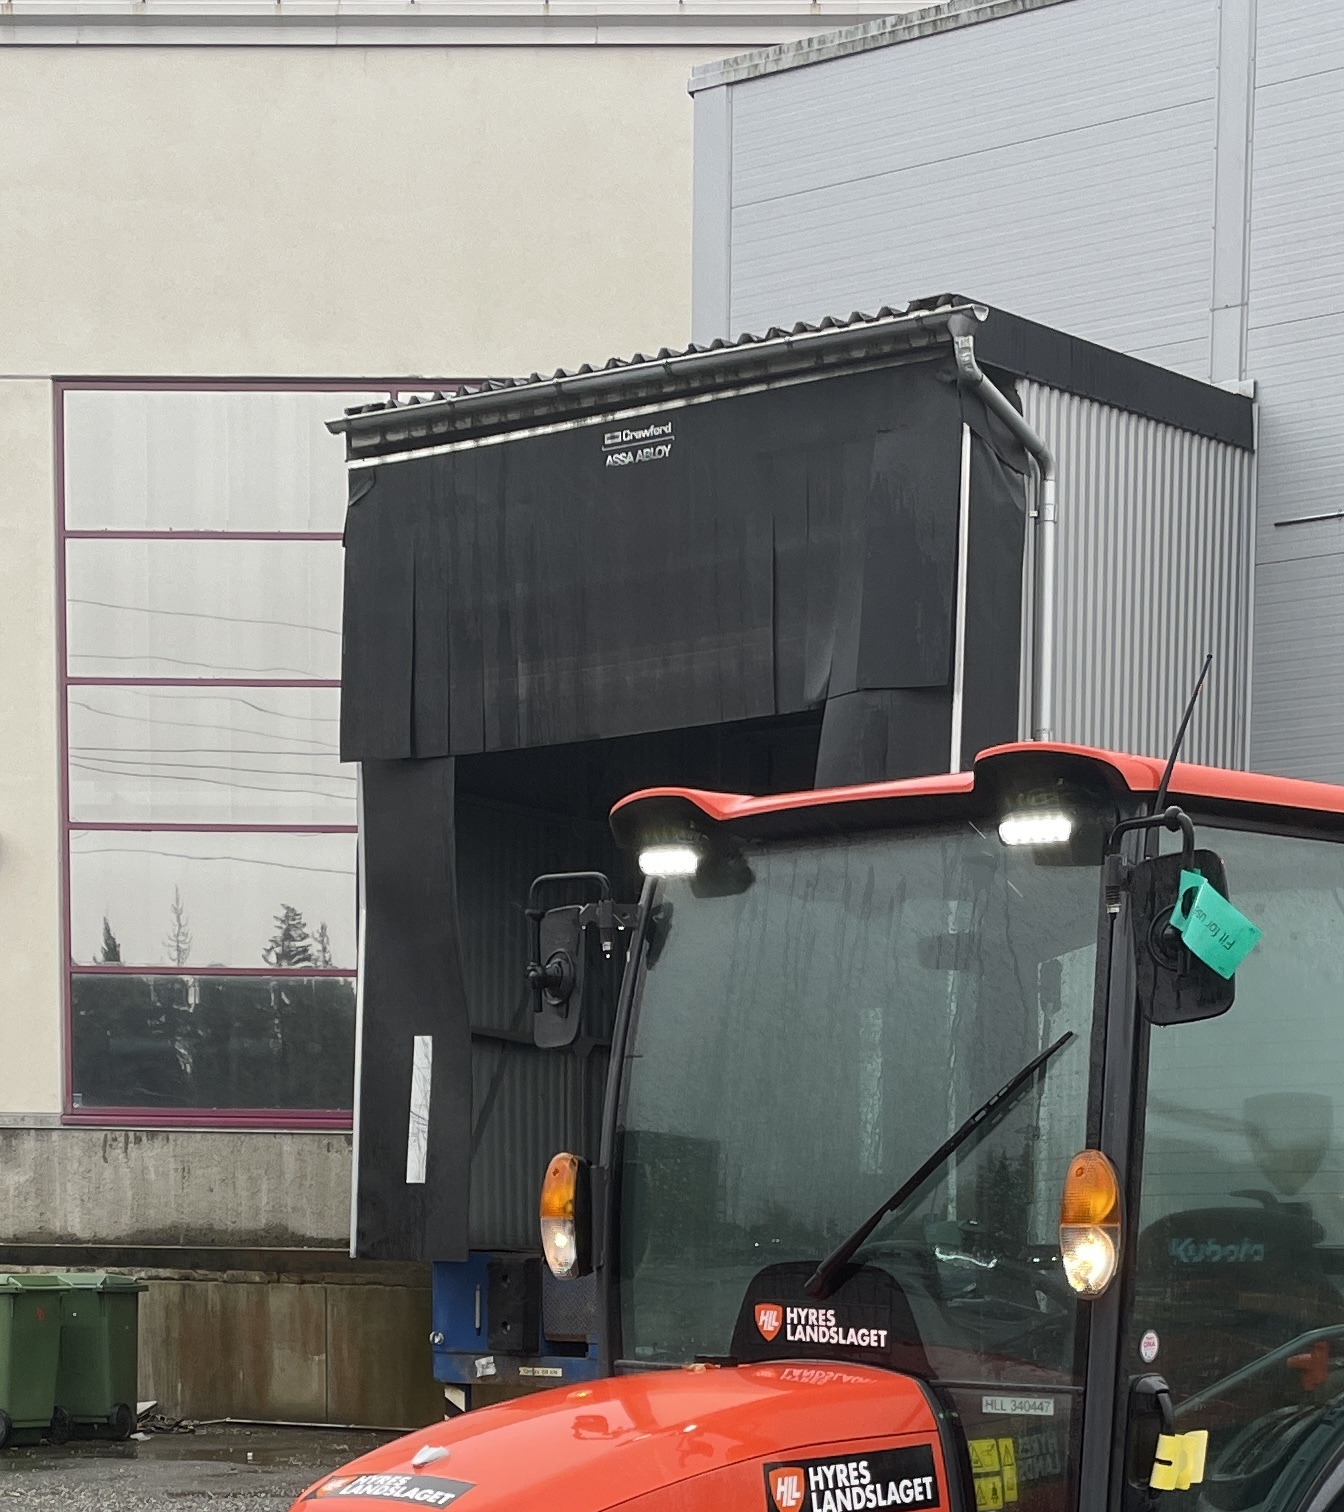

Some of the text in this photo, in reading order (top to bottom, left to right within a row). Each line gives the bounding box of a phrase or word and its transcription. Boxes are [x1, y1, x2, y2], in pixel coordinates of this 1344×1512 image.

[622, 422, 672, 442] Crawford
[606, 444, 672, 467] ASSA ABLOY
[1168, 1237, 1265, 1262] Kubota
[786, 1307, 836, 1327] HYRES
[786, 1324, 888, 1348] LANDSLAGET
[985, 1399, 1051, 1413] HLL 340447
[355, 1475, 413, 1486] HYRES
[808, 1460, 871, 1491] HYRES
[338, 1483, 456, 1505] LANDSLAGET
